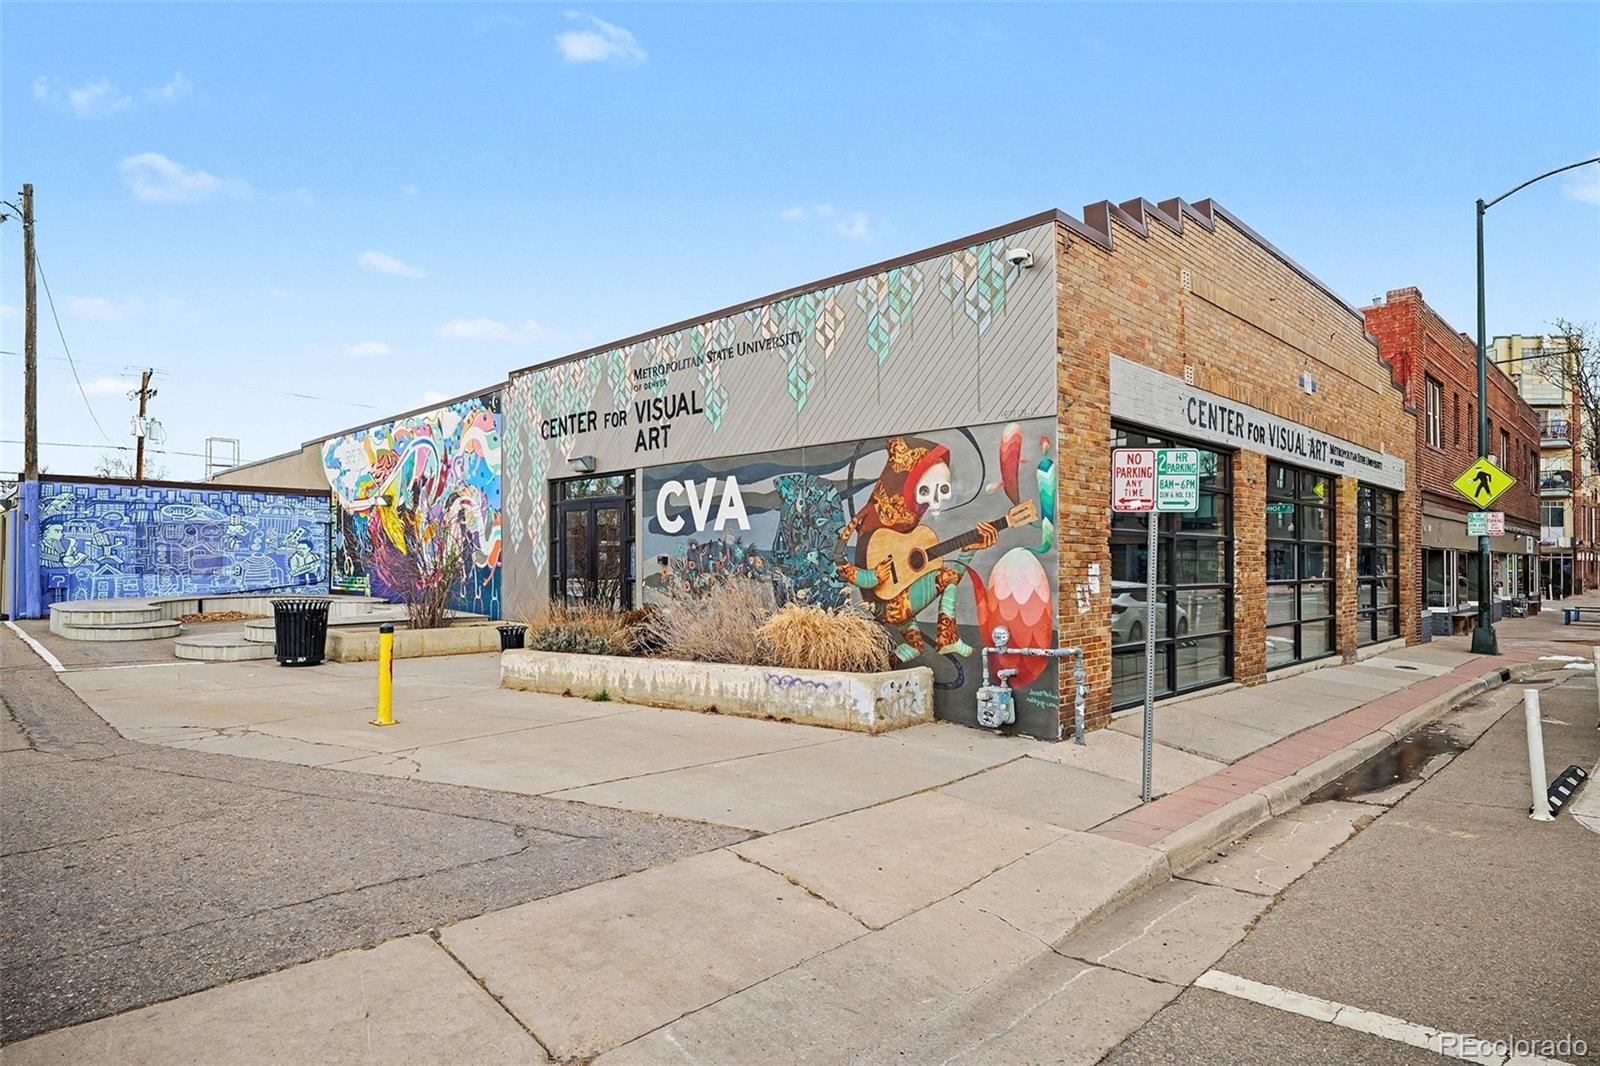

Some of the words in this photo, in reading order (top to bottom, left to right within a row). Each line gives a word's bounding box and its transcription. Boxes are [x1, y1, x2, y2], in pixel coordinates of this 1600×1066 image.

[633, 354, 704, 381] METROPOLITAN
[706, 346, 734, 364] STATE
[737, 331, 803, 356] UNIVERSITY
[541, 410, 597, 440] CENTER
[604, 410, 627, 429] FOR
[634, 390, 704, 424] VISUAL
[634, 424, 671, 453] ART
[1187, 397, 1244, 438] CENTER
[1247, 422, 1265, 444] FOR
[1268, 423, 1307, 456] VISUAL
[1309, 437, 1328, 462] ART
[1126, 453, 1142, 465] NO
[1158, 454, 1166, 472] 2
[1175, 452, 1188, 462] HR
[1167, 463, 1196, 473] PARKING
[1116, 466, 1153, 479] PARKING
[1124, 488, 1144, 497] TIME
[1125, 480, 1143, 488] ANY
[656, 475, 751, 534] CVA
